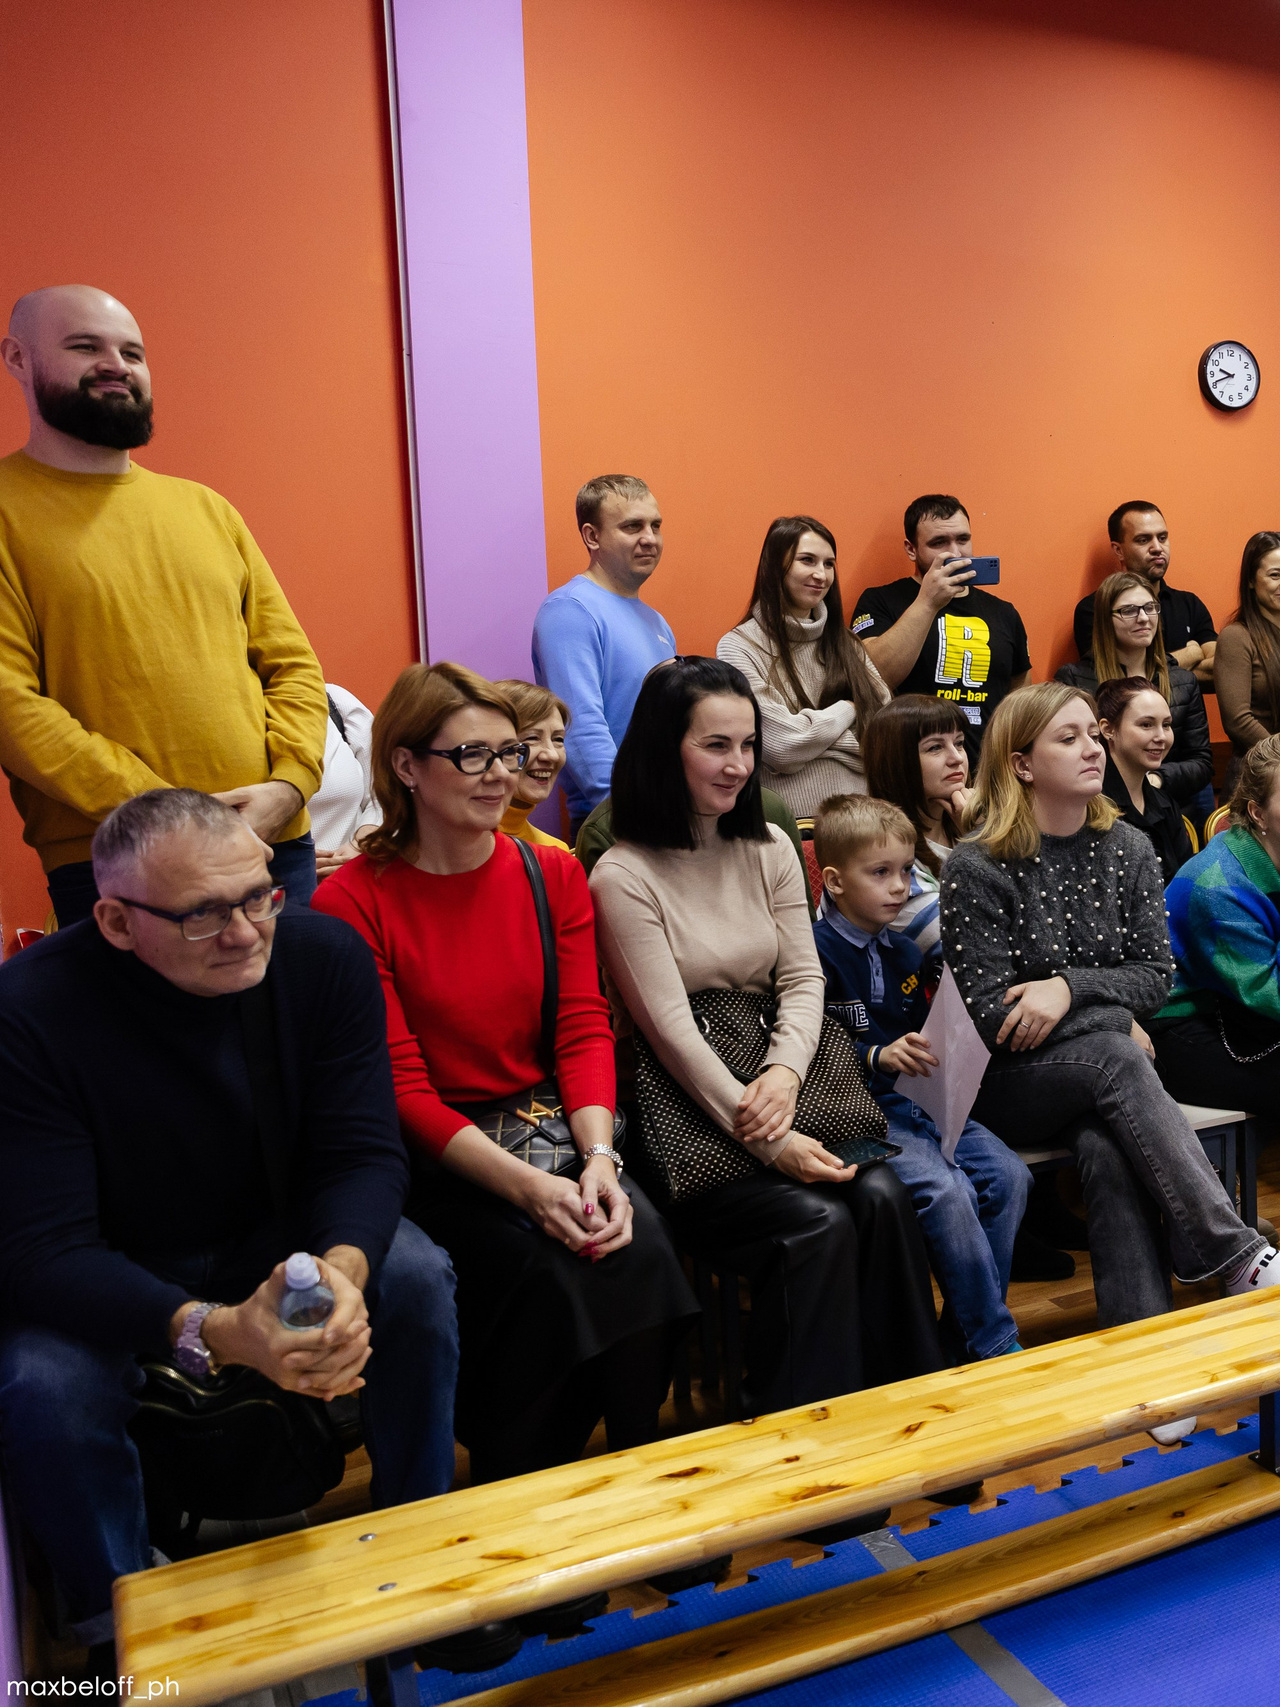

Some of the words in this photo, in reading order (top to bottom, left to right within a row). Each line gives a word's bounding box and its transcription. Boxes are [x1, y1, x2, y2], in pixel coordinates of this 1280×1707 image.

[1218, 351, 1224, 360] 11
[1226, 349, 1235, 358] 12
[1238, 353, 1242, 361] 1
[1211, 359, 1220, 367] 10
[1243, 361, 1250, 370] 2
[1209, 370, 1215, 378] 9
[1246, 373, 1252, 382] 3
[1211, 381, 1218, 390] 8
[1243, 384, 1250, 392] 4
[1218, 390, 1225, 399] 7
[1228, 394, 1234, 402] 6
[1237, 392, 1243, 400] 5
[935, 613, 991, 688] R
[936, 689, 988, 702] roll-bar
